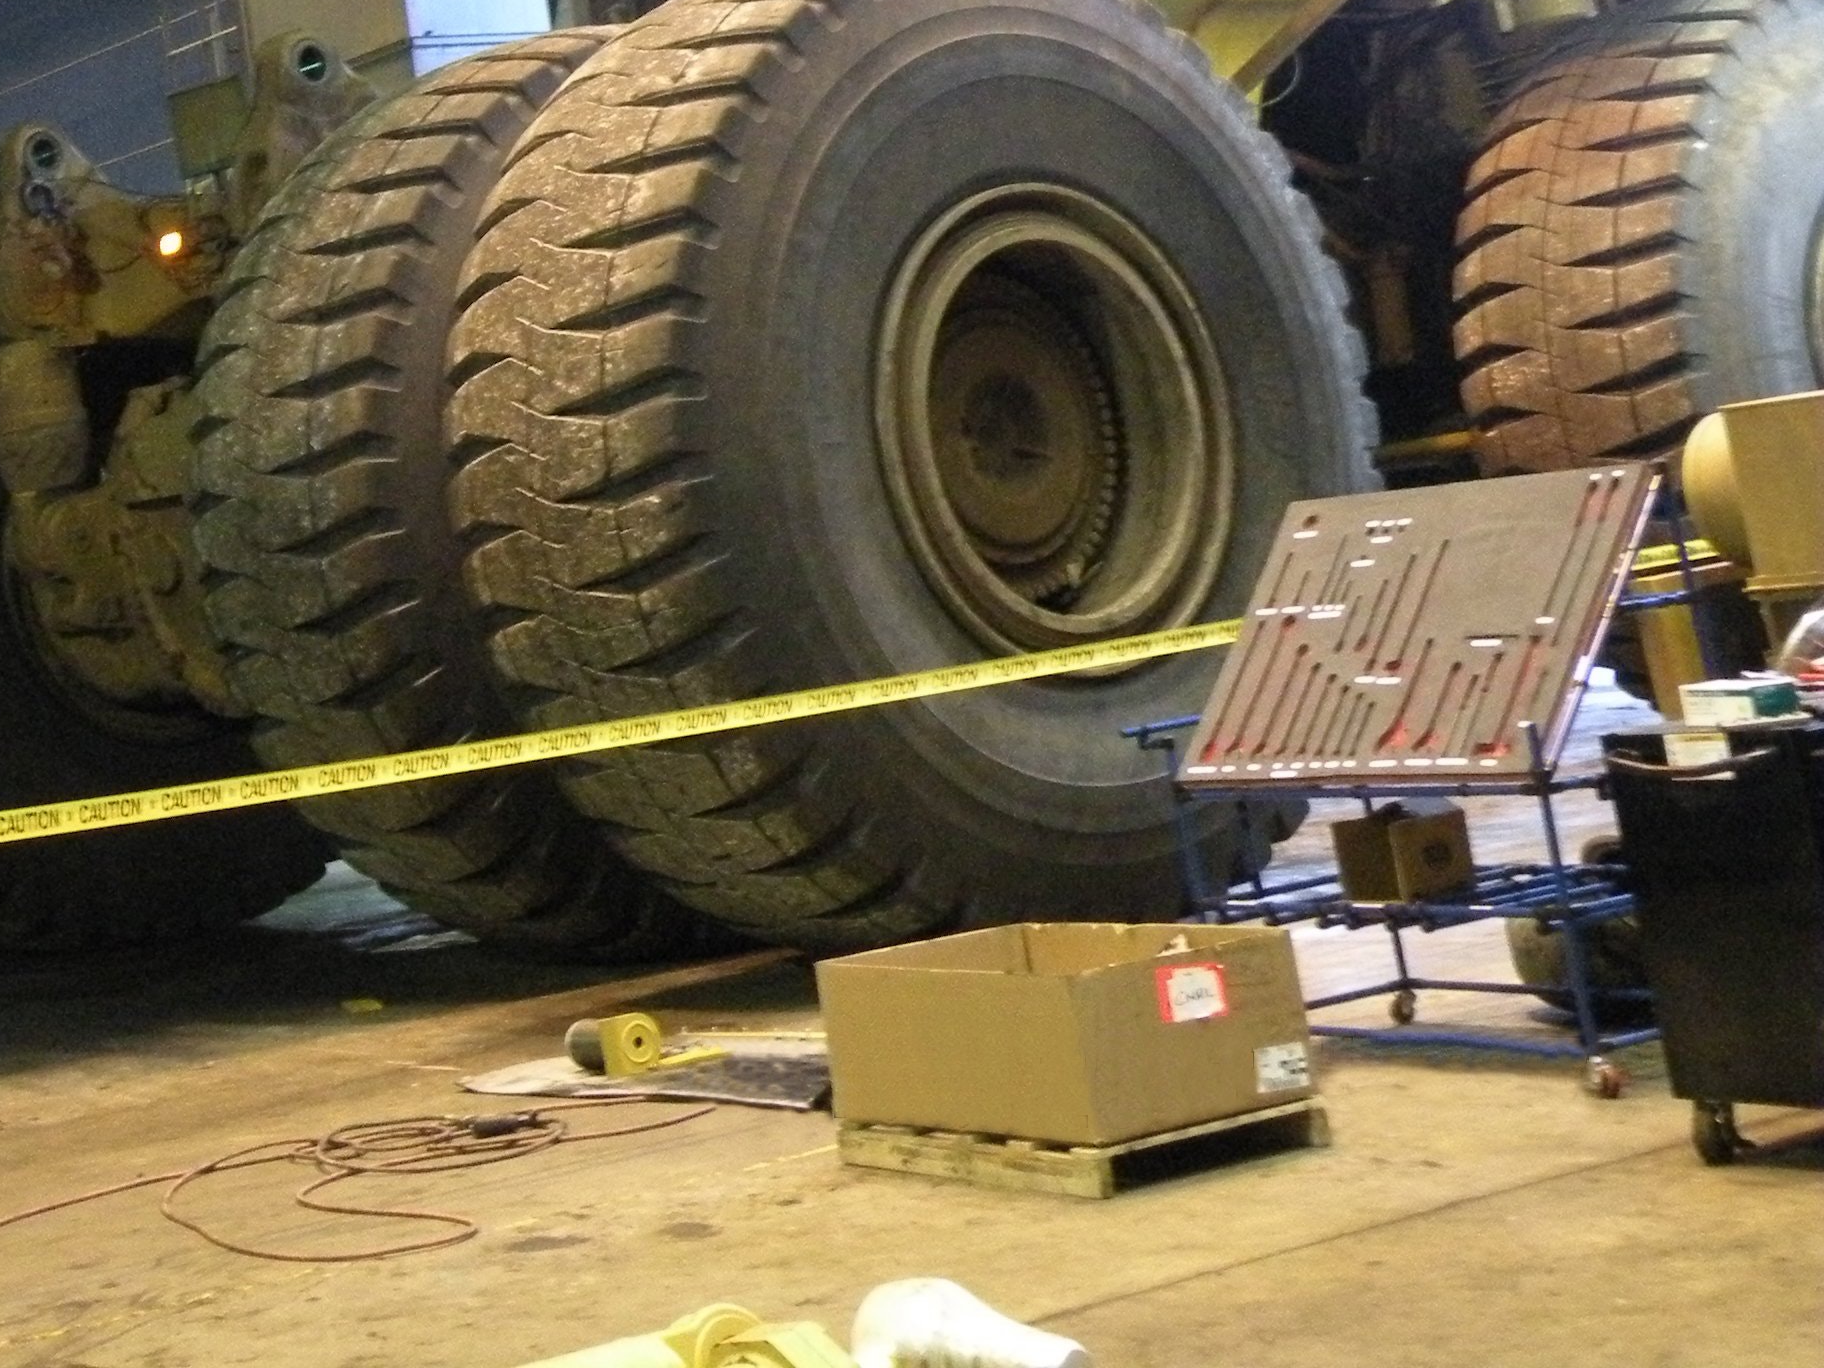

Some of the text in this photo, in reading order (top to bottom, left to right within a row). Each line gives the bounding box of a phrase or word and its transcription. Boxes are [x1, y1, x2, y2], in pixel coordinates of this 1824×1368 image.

[79, 798, 141, 824] CAUTION
[161, 785, 221, 812] CAUTION
[240, 774, 299, 800] CAUTION
[318, 763, 376, 787] CAUTION
[393, 752, 449, 777] CAUTION
[468, 741, 522, 765] CAUTION
[538, 731, 591, 754] CAUTION
[609, 720, 661, 742] CAUTION
[676, 709, 727, 731] CAUTION
[743, 698, 793, 720] CAUTION
[807, 688, 856, 709] CAUTION
